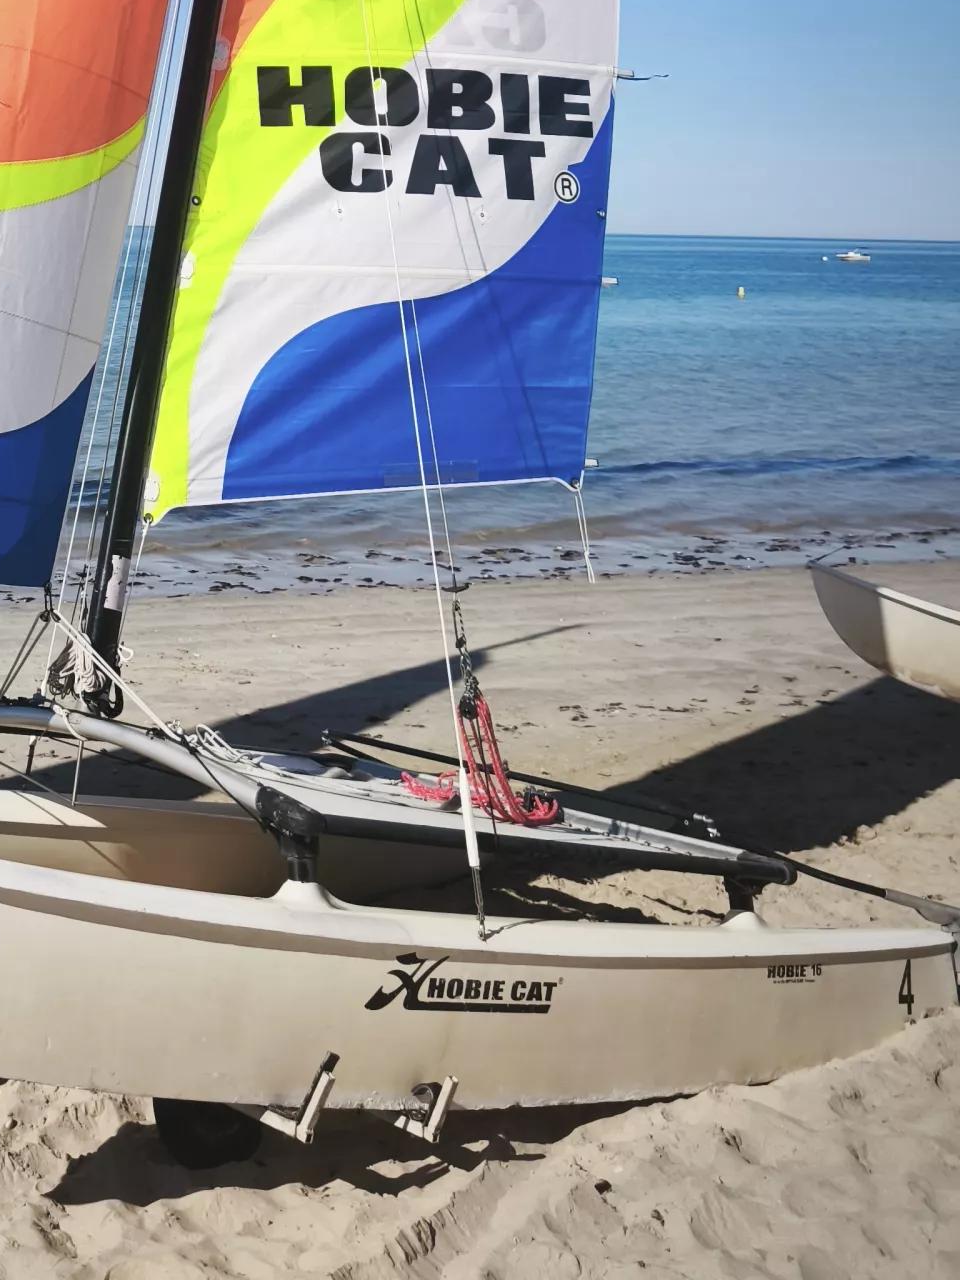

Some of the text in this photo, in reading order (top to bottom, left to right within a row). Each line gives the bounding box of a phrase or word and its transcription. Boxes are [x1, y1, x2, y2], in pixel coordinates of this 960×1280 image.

[256, 65, 594, 138] HOBIE
[319, 131, 546, 201] CAT
[427, 977, 506, 1001] HOBIE
[766, 962, 823, 979] HOBIE 16
[898, 958, 915, 1016] 4
